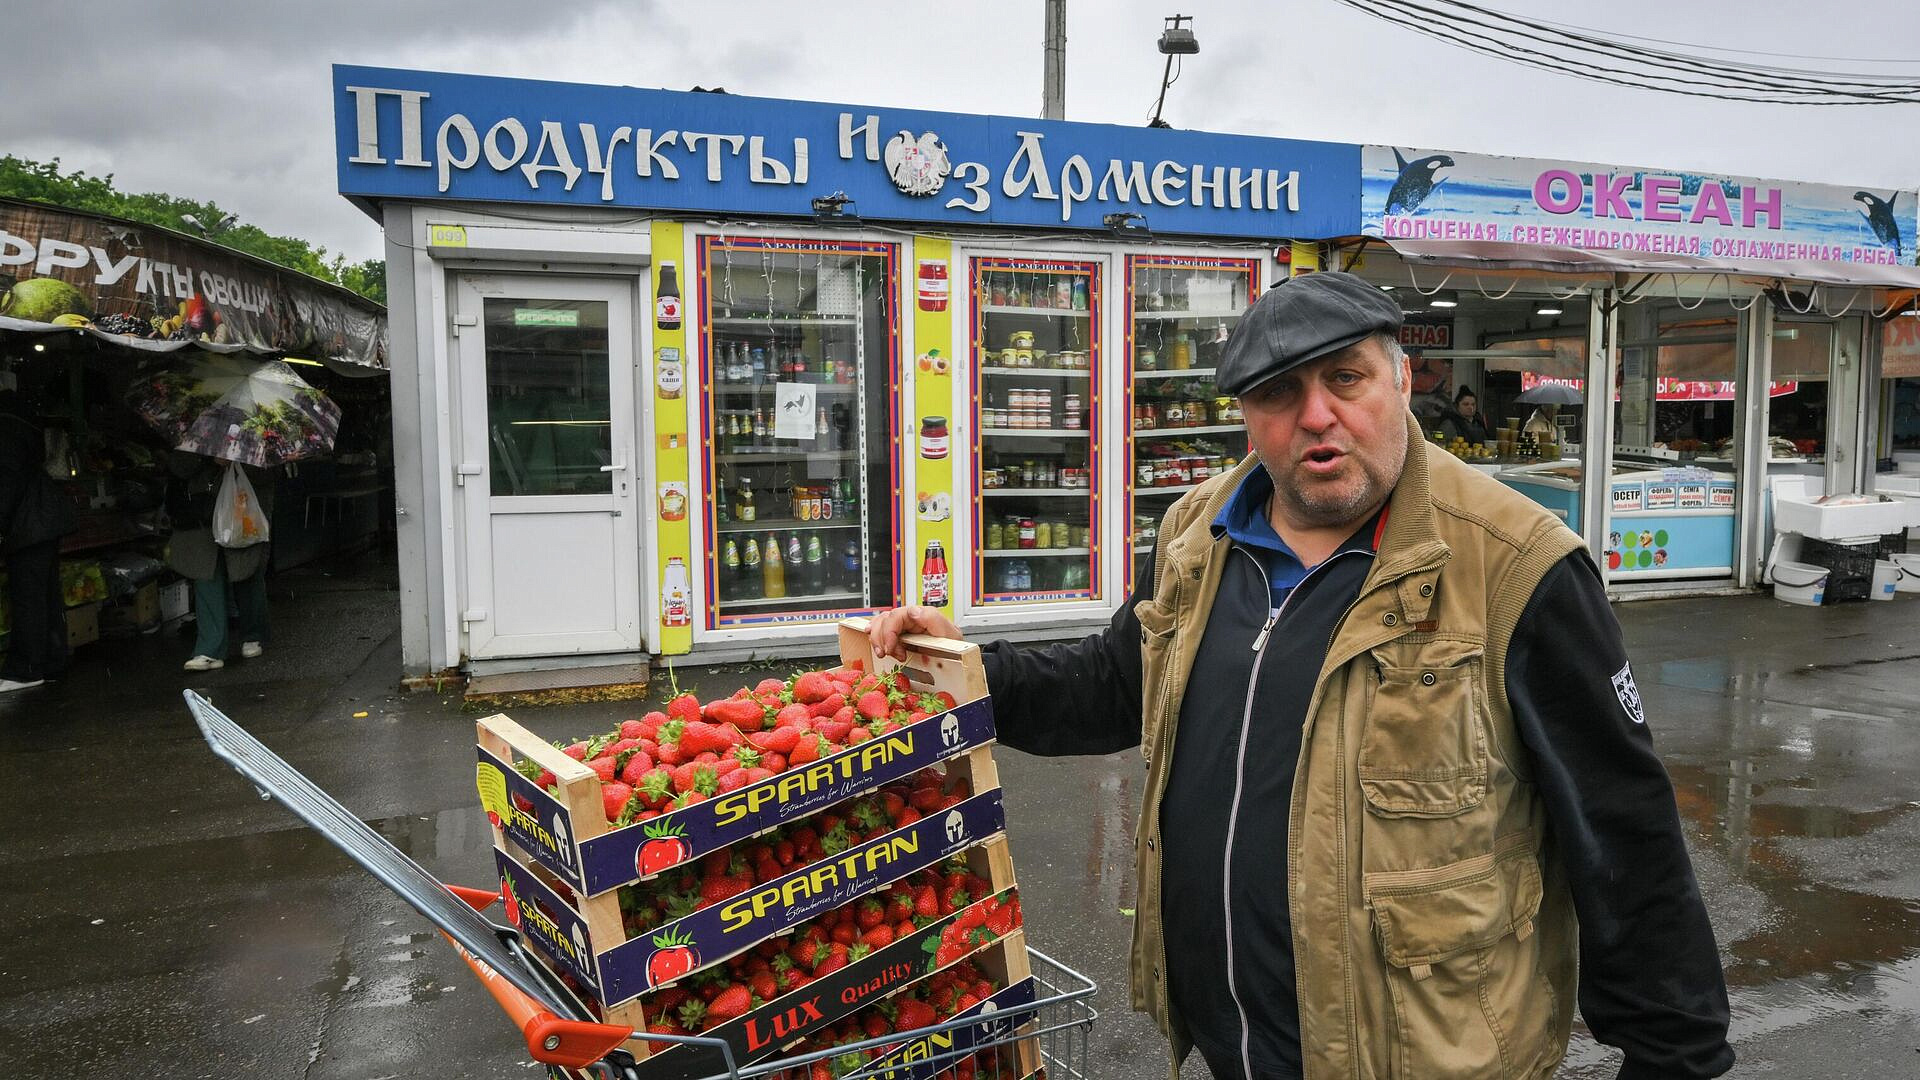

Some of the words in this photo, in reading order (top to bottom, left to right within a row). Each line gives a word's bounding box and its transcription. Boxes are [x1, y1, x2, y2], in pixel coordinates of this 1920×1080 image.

[345, 85, 808, 201] Продукты
[1001, 131, 1300, 221] Армении
[1533, 168, 1783, 230] ОКЕАН
[436, 230, 463, 242] 099
[763, 242, 840, 251] АРМЕНИЯ
[1383, 215, 1499, 241] КОПЧЕНАЯ
[1512, 226, 1700, 255] СВЕЖЕМОРОЖЕНАЯ
[1710, 238, 1842, 262] ОХЛАЖДЕННАЯ
[1852, 248, 1897, 265] РЫБА
[1008, 262, 1065, 271] АРМЕНИЯ
[199, 270, 271, 317] ОВОЩИ
[1613, 490, 1641, 501] ОСЕТР
[770, 613, 846, 623] АРМЕНИЯ
[714, 731, 914, 827] SPARTAN
[508, 805, 557, 852] PARTAN
[720, 830, 918, 934] SPARTAN
[521, 901, 576, 959] SPARTAN
[841, 960, 913, 1005] Quality
